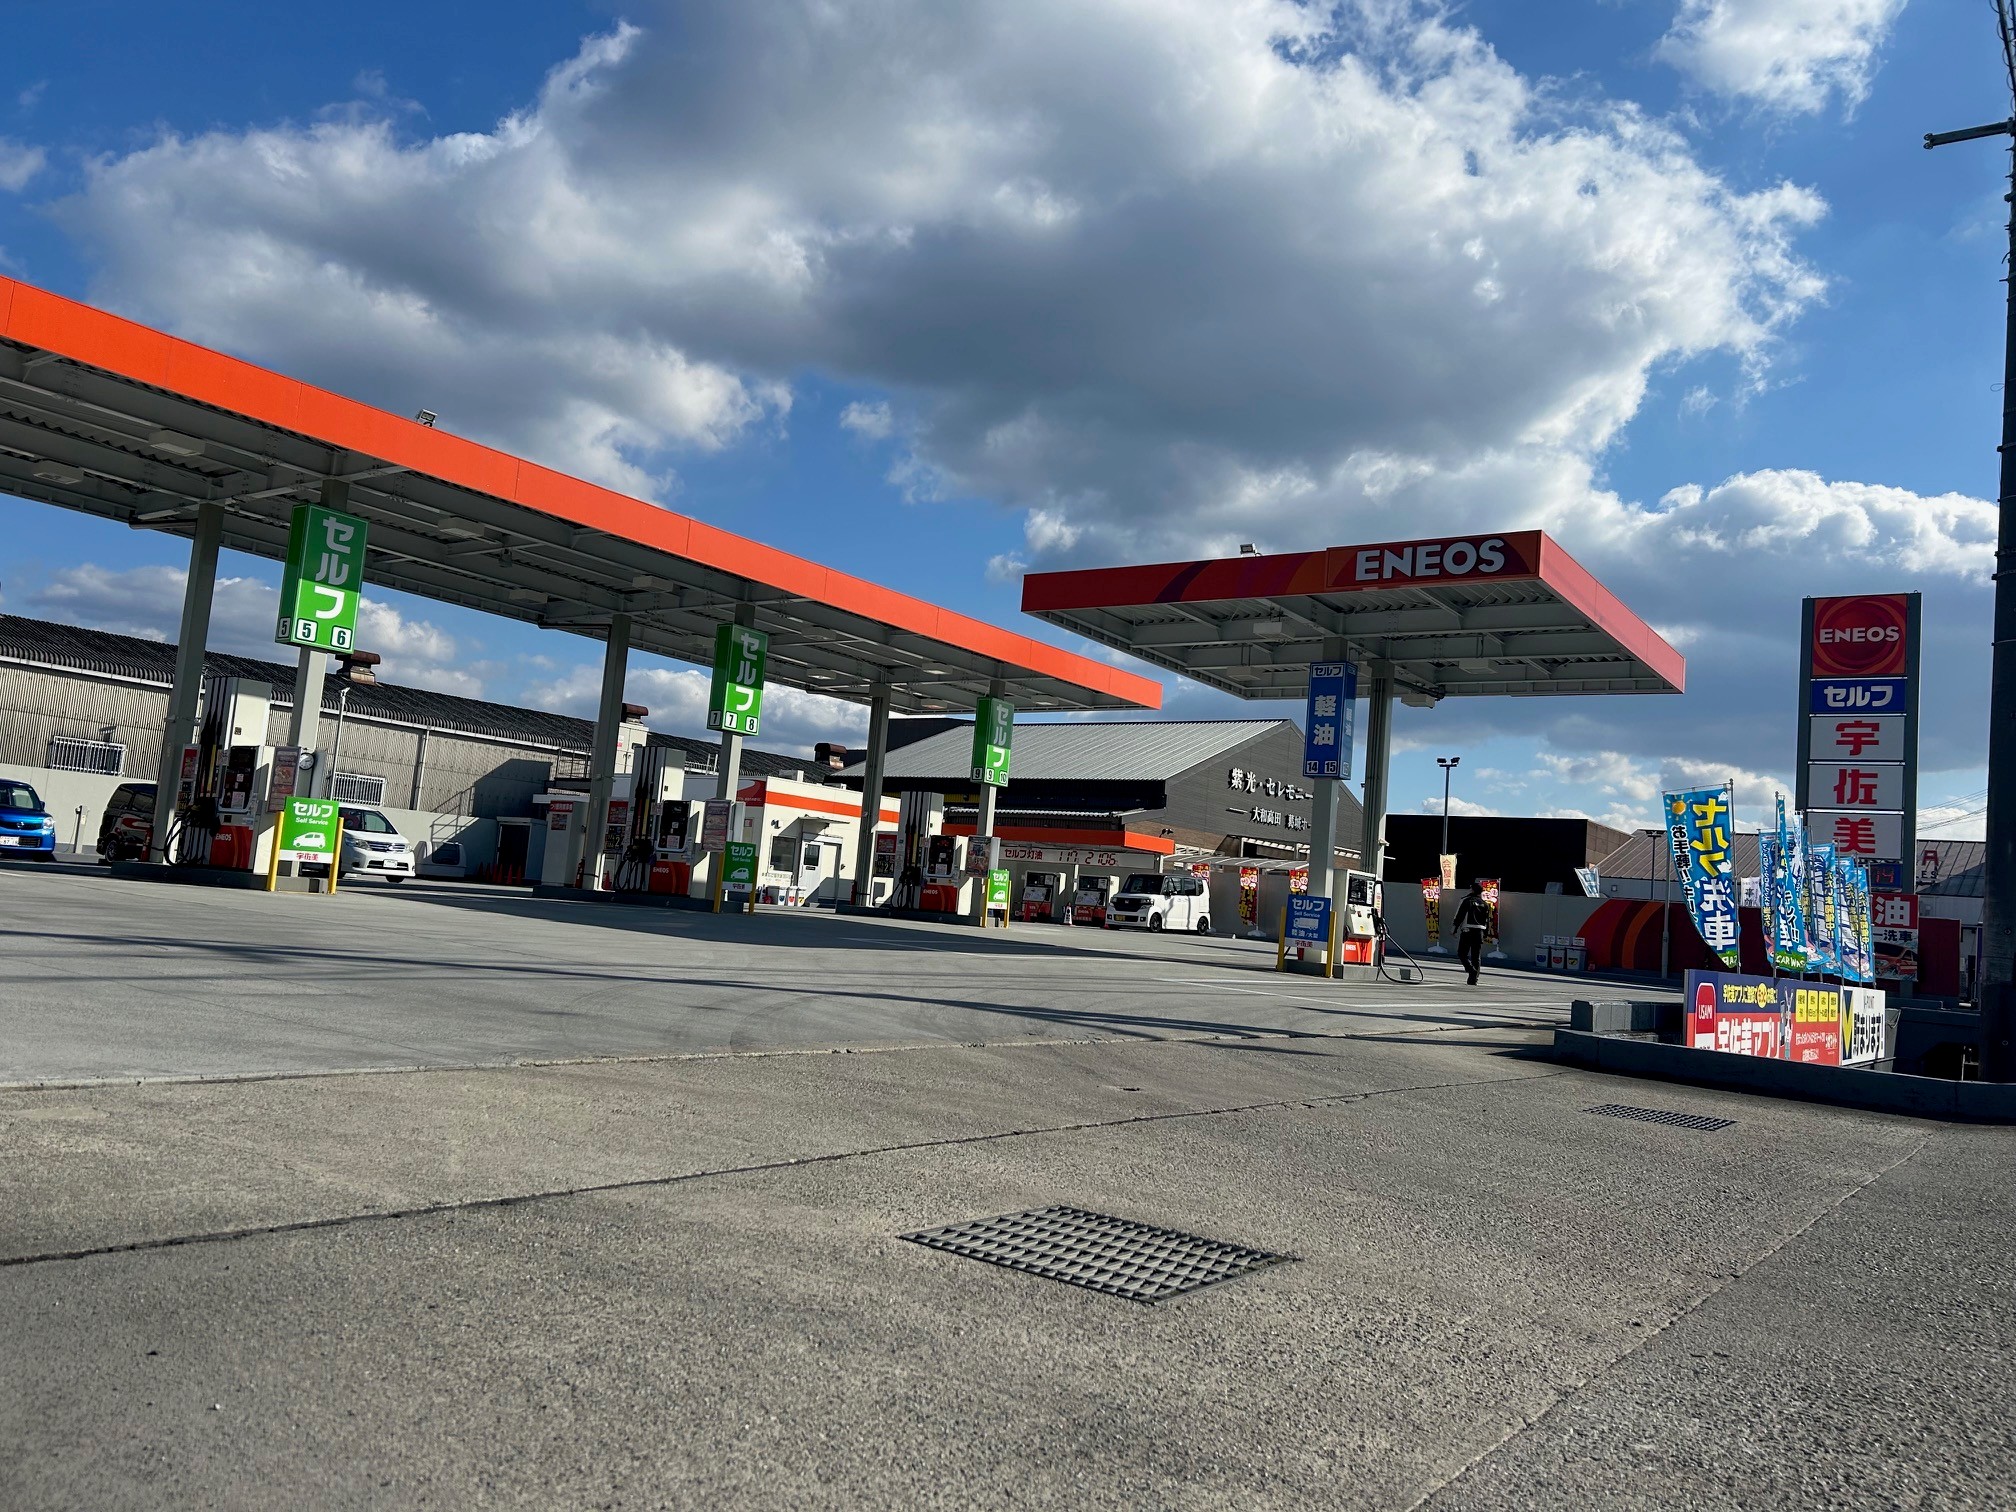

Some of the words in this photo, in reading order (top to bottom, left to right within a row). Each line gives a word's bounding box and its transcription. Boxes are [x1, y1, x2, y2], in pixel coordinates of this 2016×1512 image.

[1355, 538, 1506, 581] ENEOS
[314, 516, 355, 620] セルフ
[281, 620, 288, 635] 5
[302, 623, 312, 639] 5
[337, 630, 347, 645] 6
[1819, 626, 1900, 644] ENEOS
[736, 633, 760, 712] セルフ
[1314, 666, 1343, 677] セルフ
[1823, 685, 1894, 708] セルフ
[713, 713, 718, 725] 7
[729, 715, 734, 726] 7
[748, 719, 755, 731] 8
[1312, 694, 1338, 746] 軽油
[993, 703, 1009, 768] セルフ
[975, 768, 981, 779] 9
[1306, 761, 1319, 774] 14
[1324, 761, 1337, 774] 15
[988, 769, 993, 779] 9
[1000, 773, 1007, 783] 10
[1832, 719, 1881, 855] 宇佐美
[293, 801, 334, 818] セルフ
[308, 818, 329, 826] Service
[731, 845, 754, 857] セルフ
[1004, 848, 1043, 861] セルフ灯油
[652, 866, 670, 874] ENEOS
[992, 872, 1008, 882] セルフ
[1291, 898, 1325, 912] セルフ
[1698, 1005, 1713, 1020] USAMI
